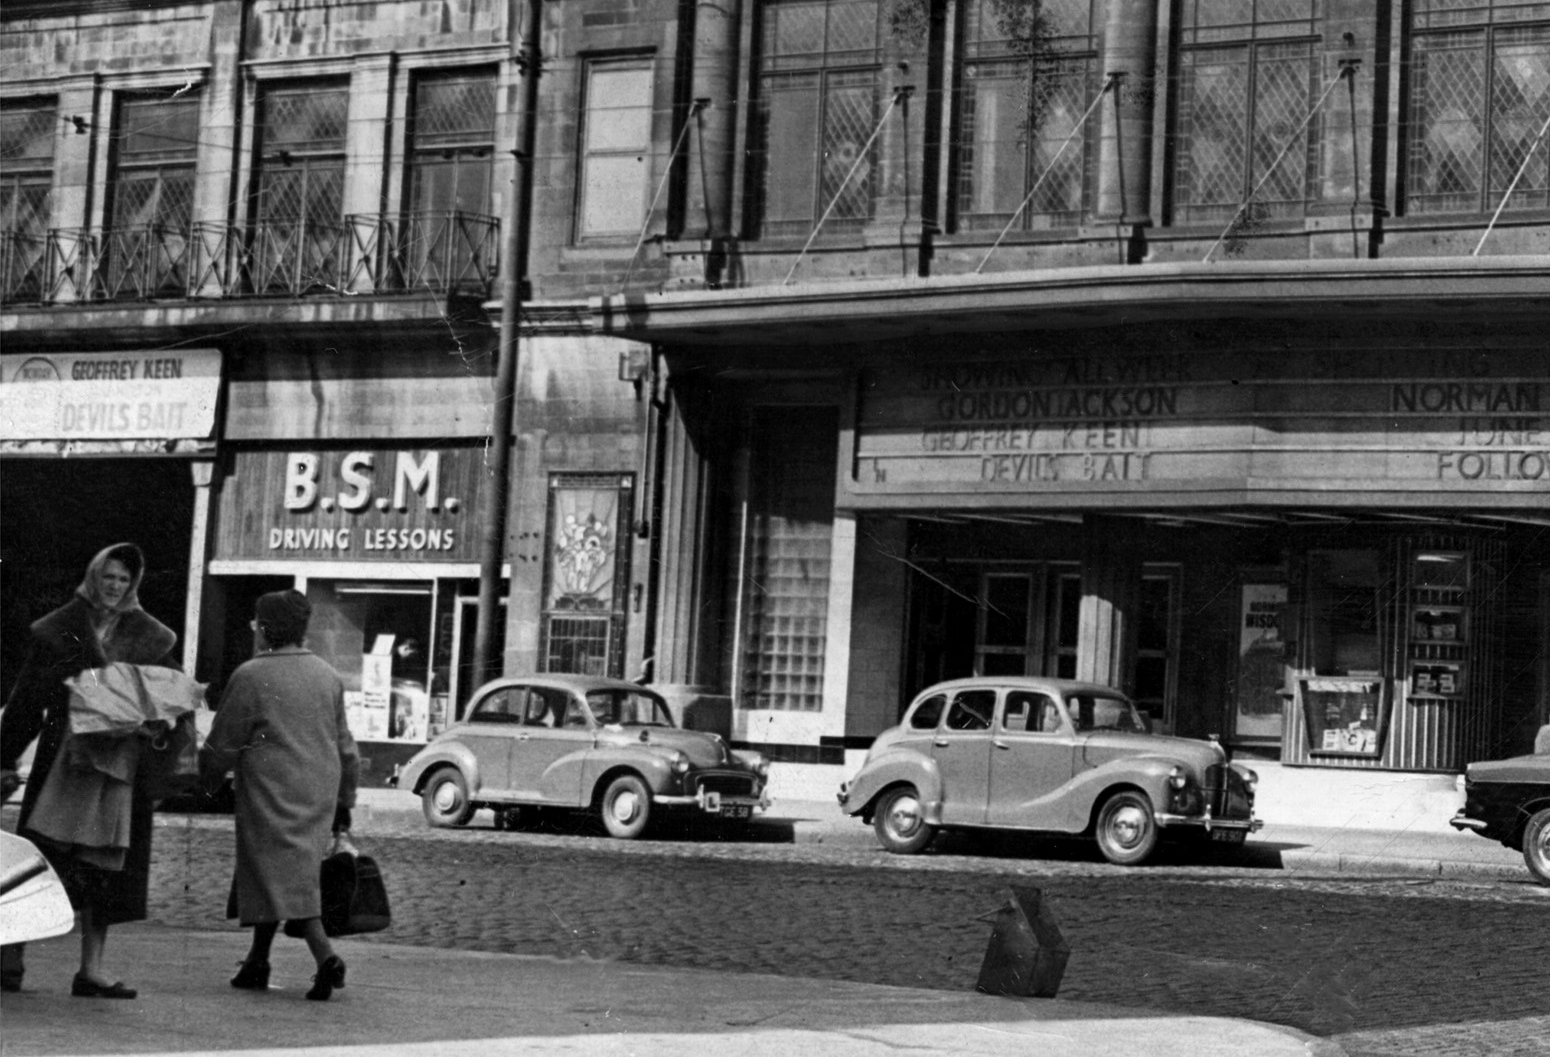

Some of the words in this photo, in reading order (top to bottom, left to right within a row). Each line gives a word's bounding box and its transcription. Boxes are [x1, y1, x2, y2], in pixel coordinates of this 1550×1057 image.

[71, 360, 138, 381] GEOFFREY
[143, 358, 183, 379] KEEN
[939, 391, 1051, 421] GORDON
[1392, 382, 1541, 413] NORMAN
[62, 402, 131, 432] DEVILS
[137, 400, 188, 432] BAIT
[922, 422, 1040, 453] GEOFFREY
[1061, 420, 1142, 449] KEEN
[1459, 417, 1541, 447] JUNE
[283, 450, 461, 515] B.S.M.
[980, 453, 1059, 483] DEVILS
[1082, 451, 1151, 481] BAIT
[269, 527, 351, 551] DRIVING
[364, 528, 455, 551] LESSONS
